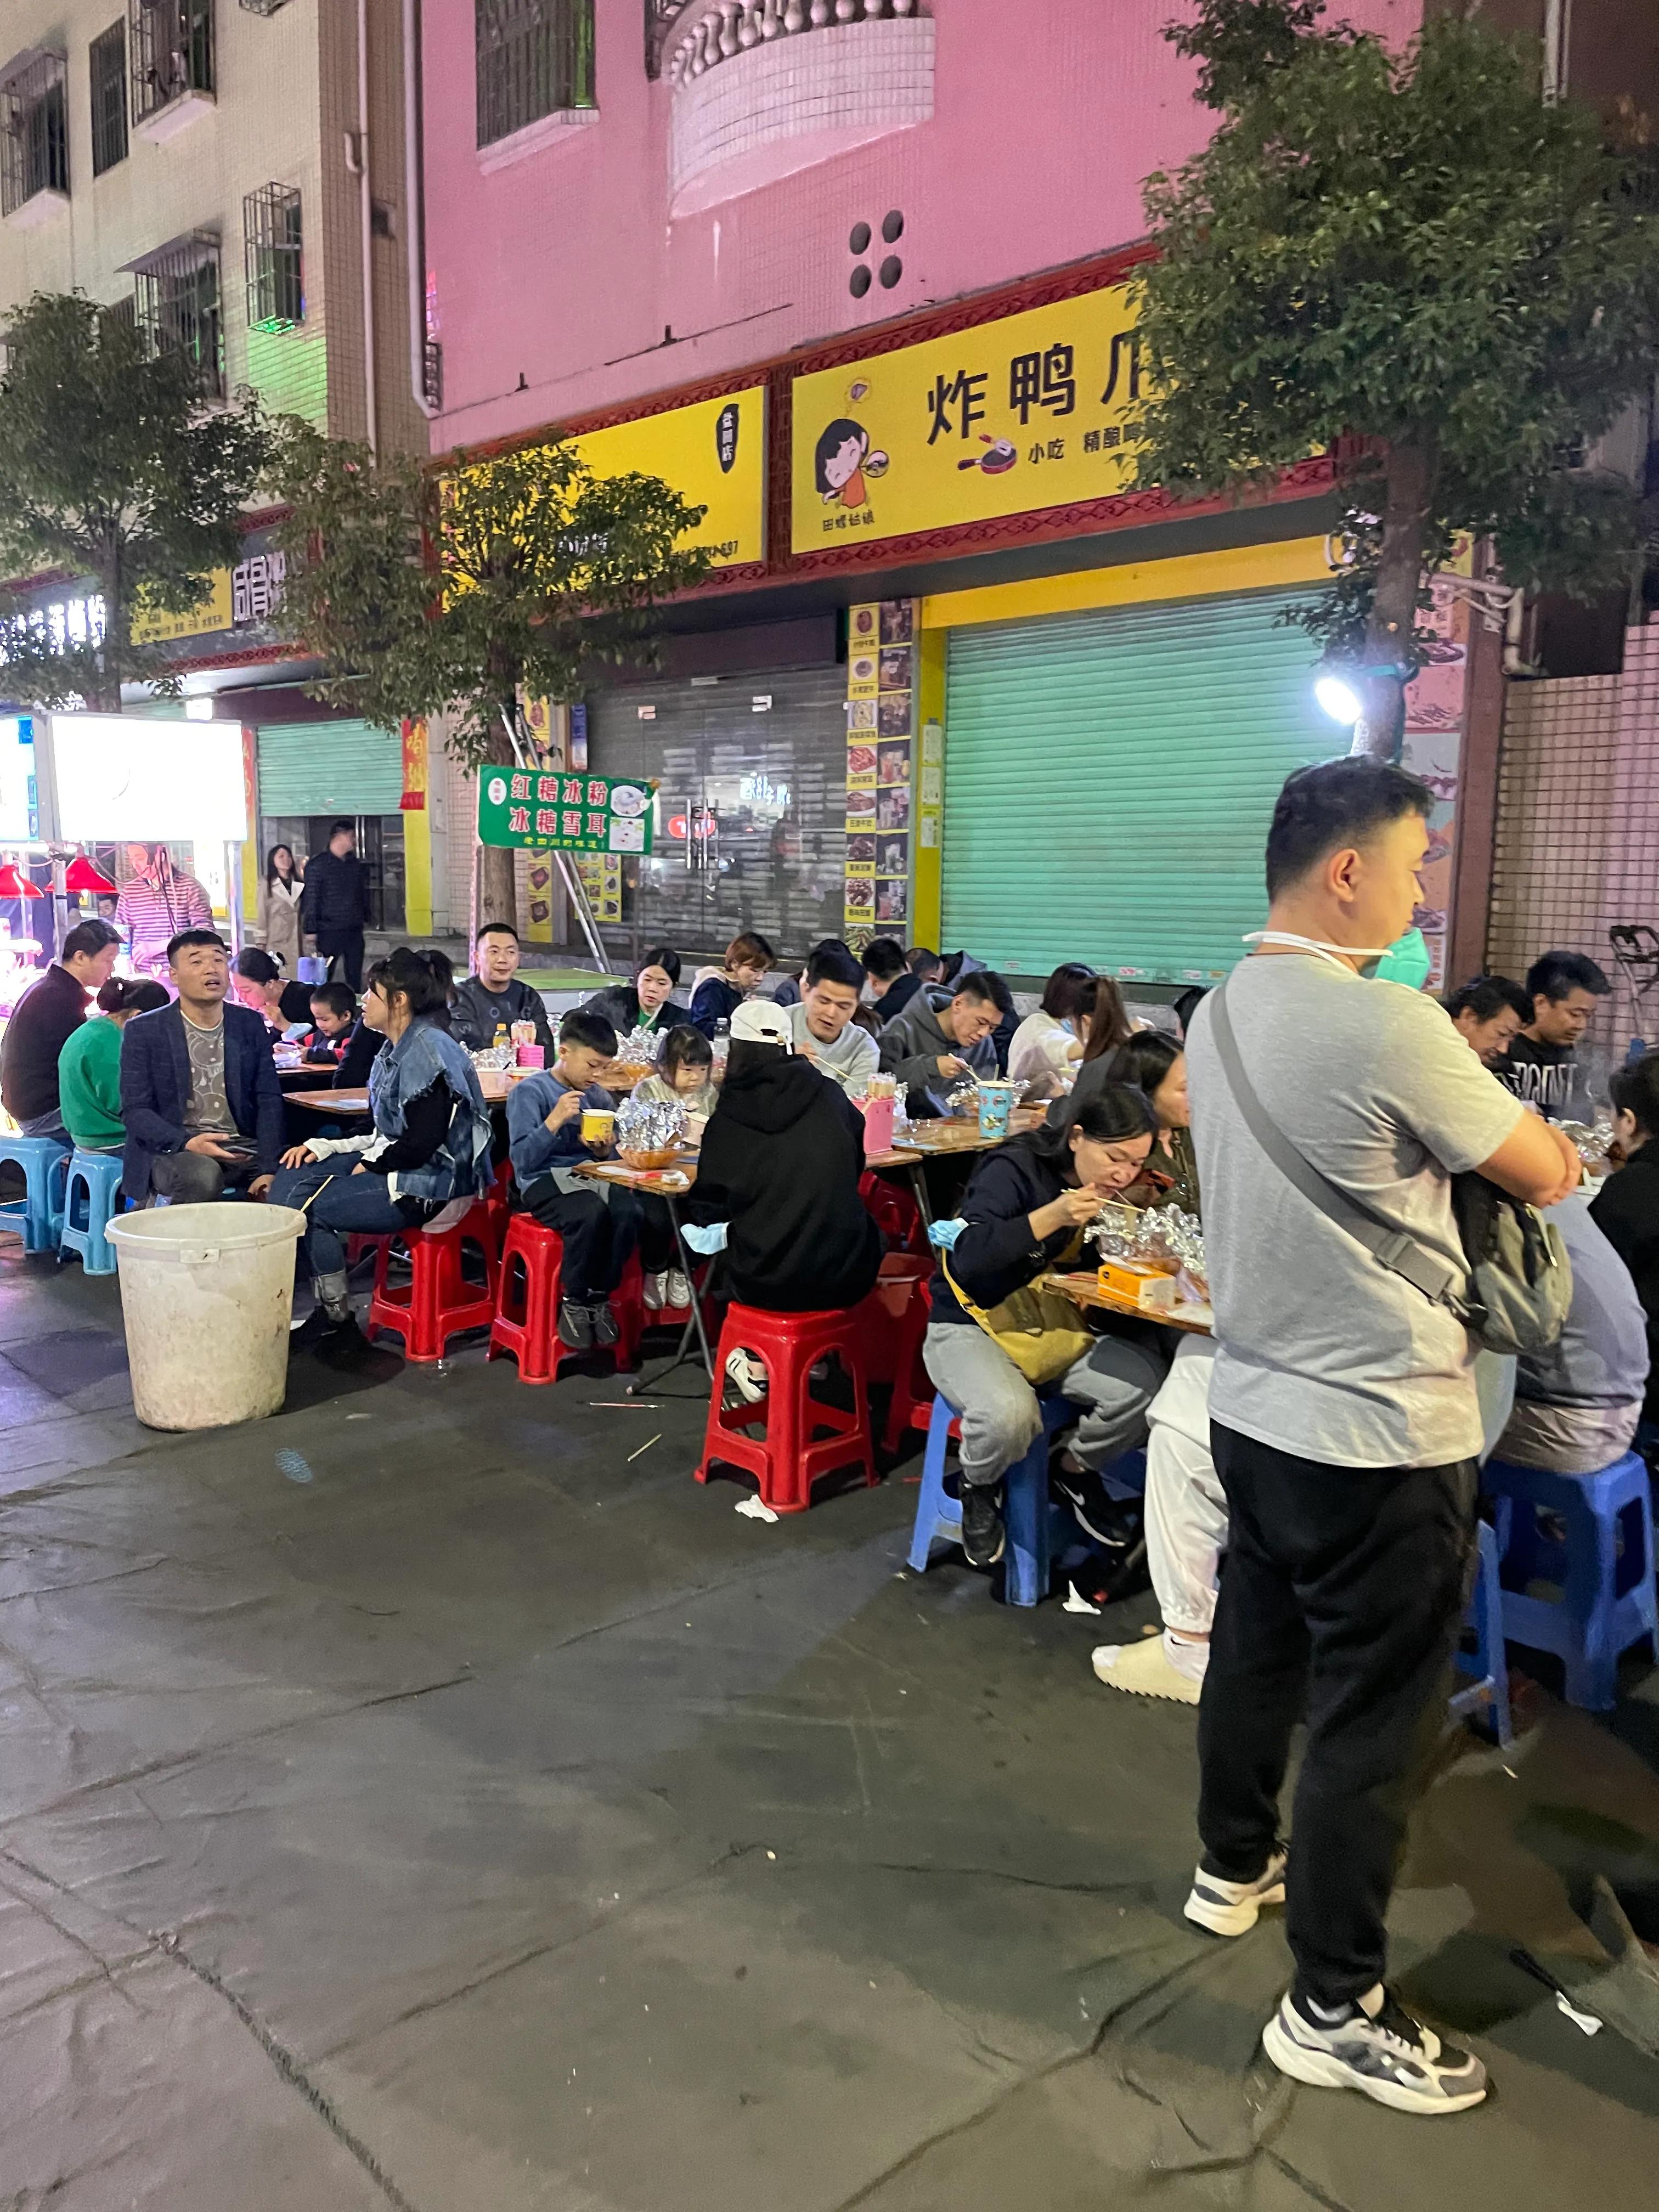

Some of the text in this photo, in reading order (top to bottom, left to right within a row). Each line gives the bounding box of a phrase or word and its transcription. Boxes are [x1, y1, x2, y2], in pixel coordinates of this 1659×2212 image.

[1028, 438, 1065, 464] 小吃
[510, 774, 608, 806] 红糖冰粉
[508, 806, 607, 838] 冰糖雪耳
